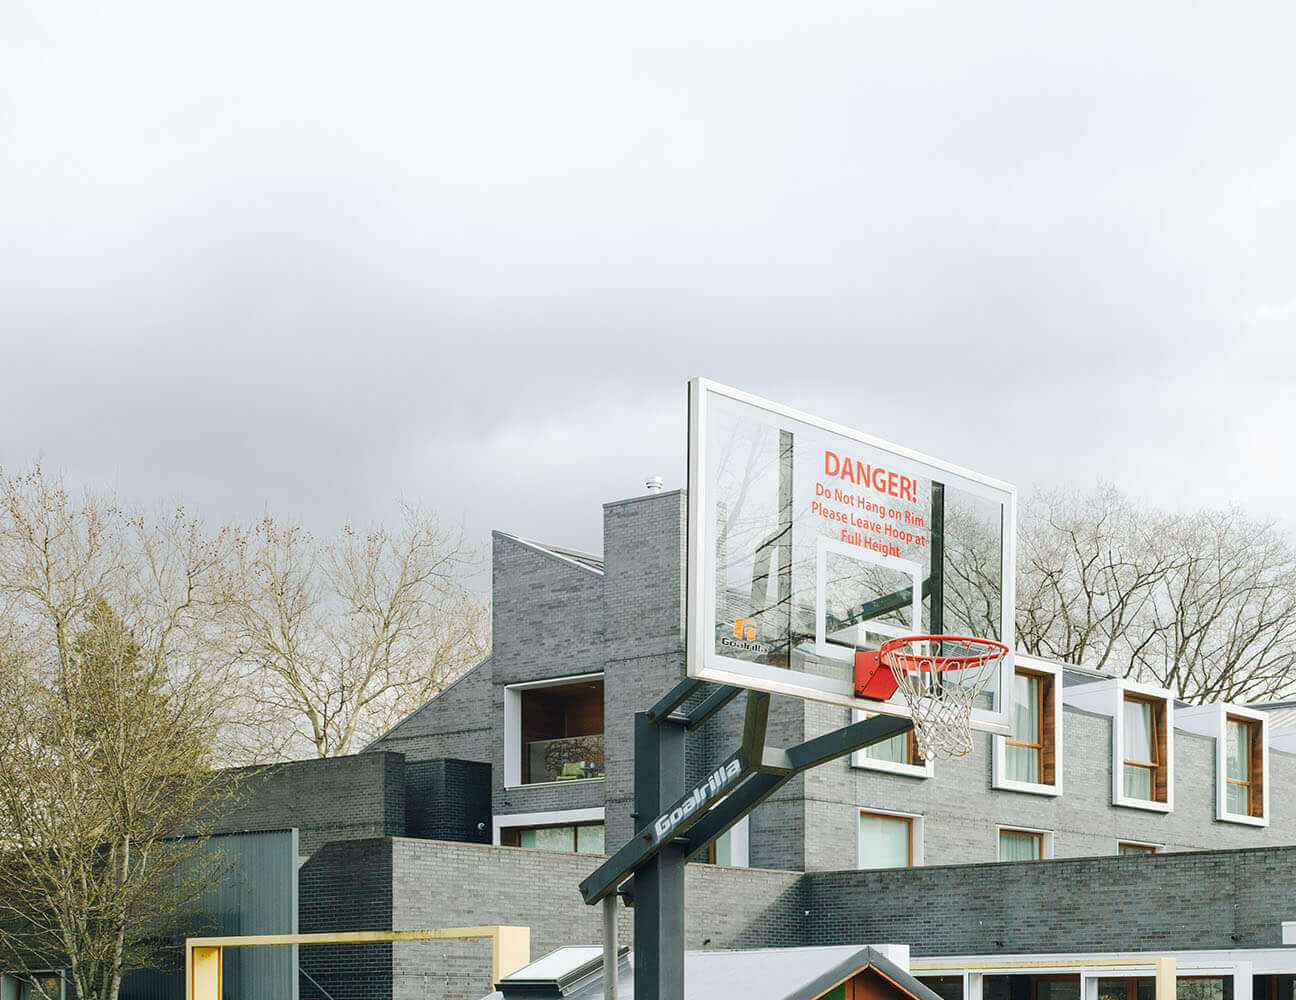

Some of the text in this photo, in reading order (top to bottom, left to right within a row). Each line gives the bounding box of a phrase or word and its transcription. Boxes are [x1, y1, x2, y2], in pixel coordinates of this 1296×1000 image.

[825, 450, 917, 503] DANGER!
[811, 501, 925, 547] Please Leave Hoop at
[816, 482, 925, 528] Do Not Hang on Rim
[841, 529, 901, 558] Full Height
[654, 759, 741, 838] Goalrilla
